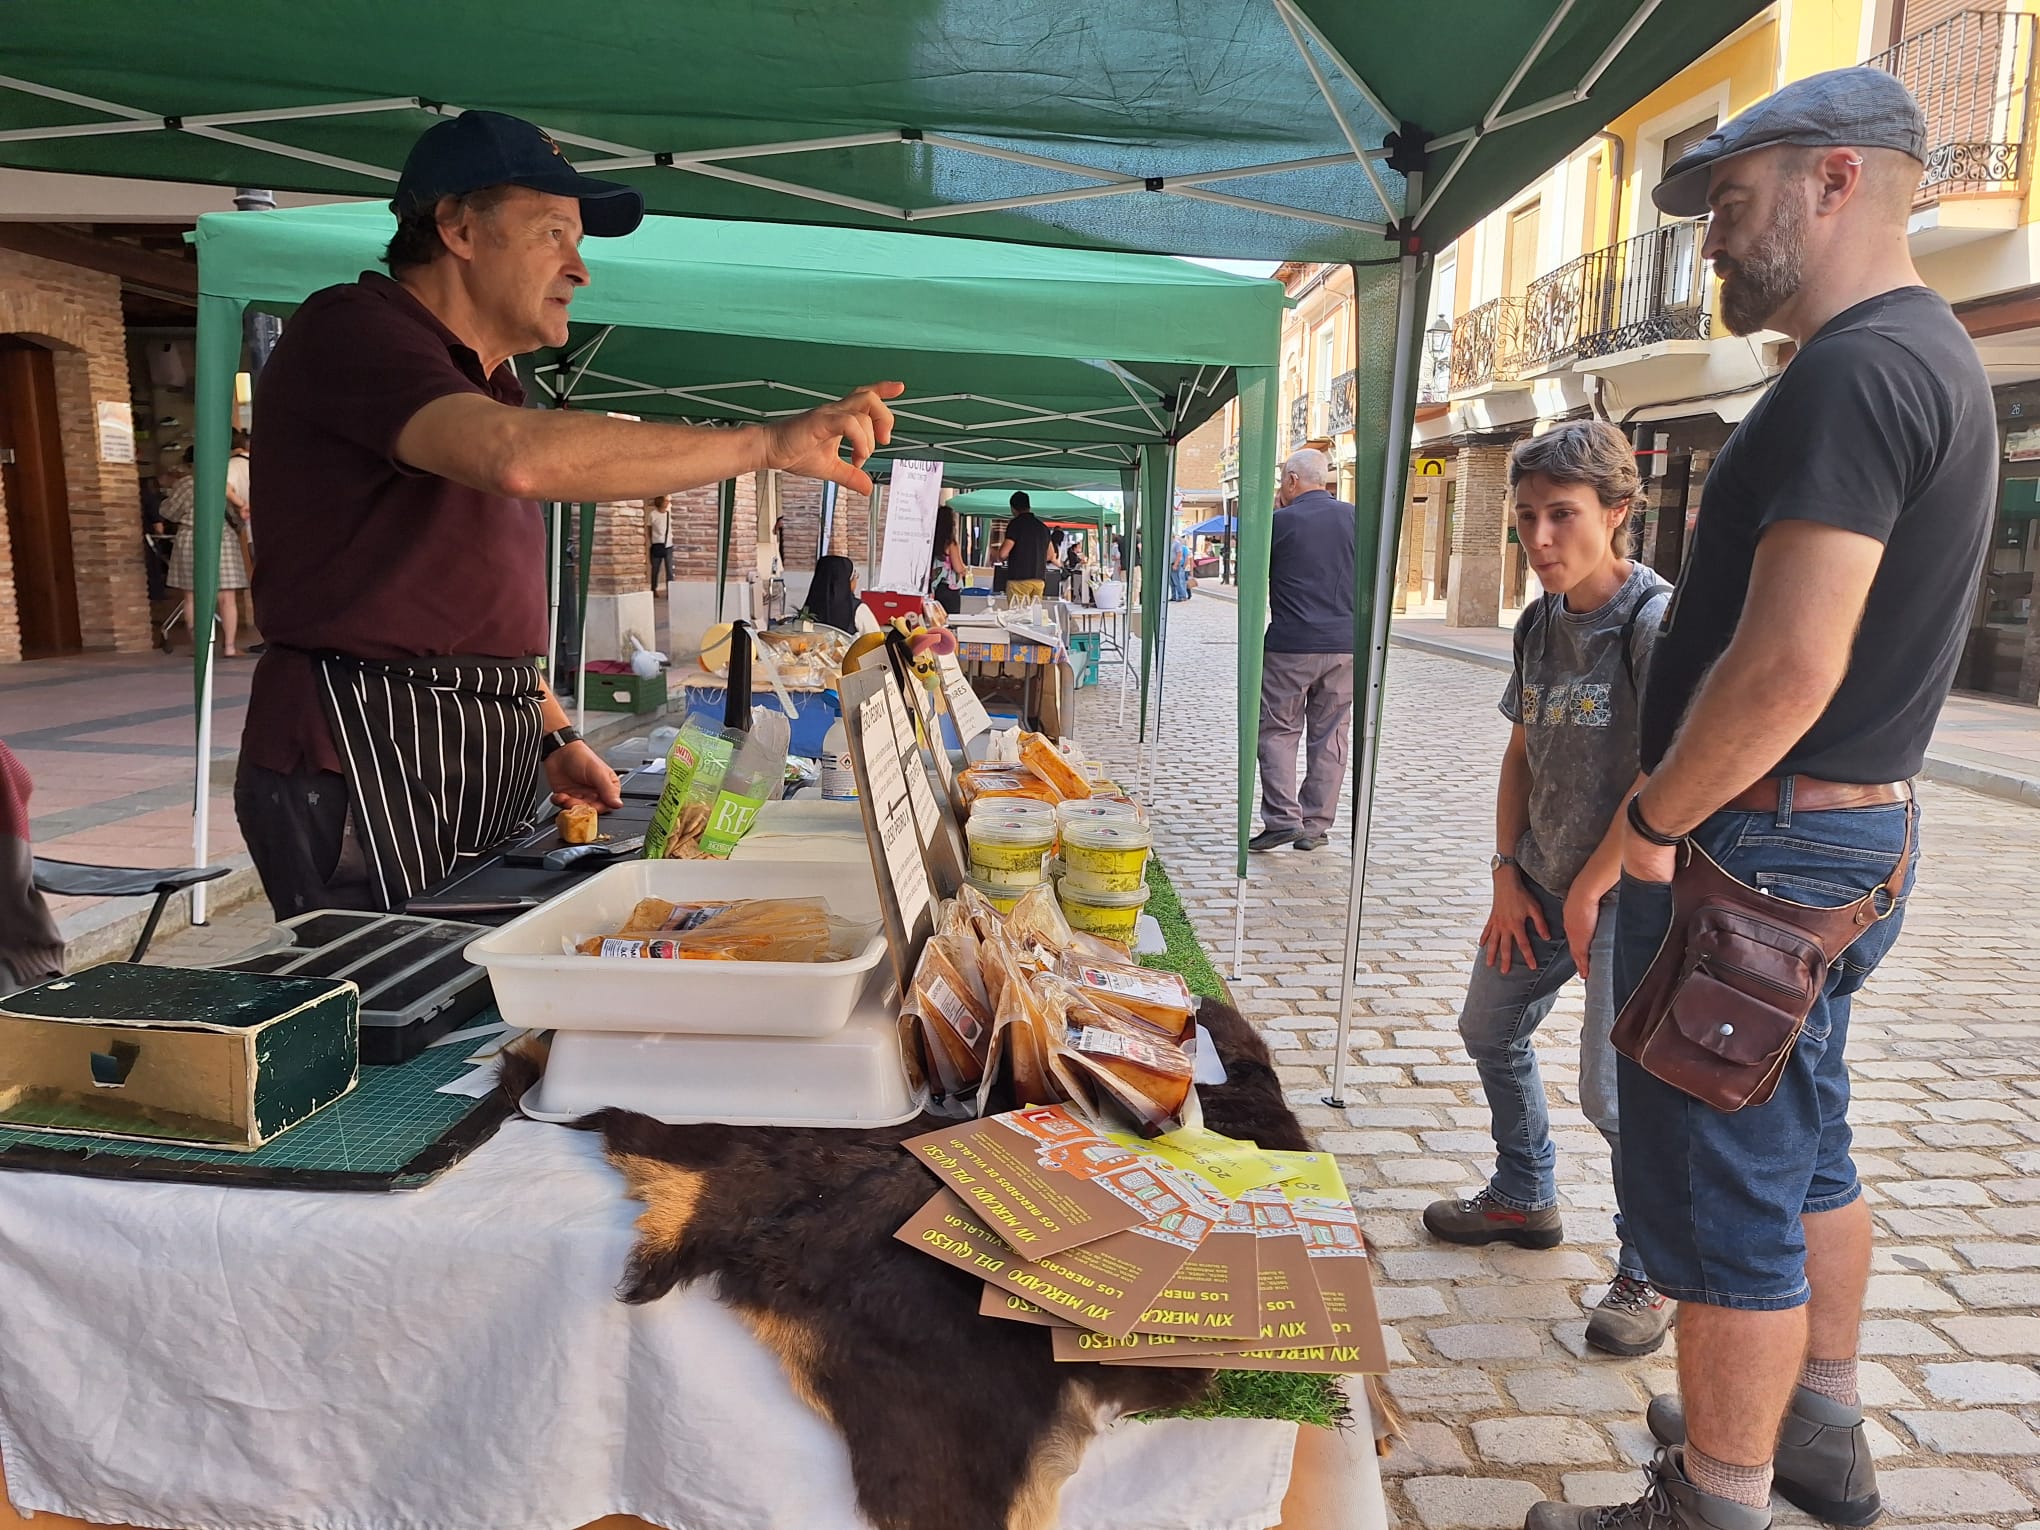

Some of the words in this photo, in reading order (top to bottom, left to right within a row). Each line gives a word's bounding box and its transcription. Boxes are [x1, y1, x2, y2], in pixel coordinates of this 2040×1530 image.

[922, 1144, 958, 1169] QUESO
[951, 1139, 988, 1169] VILLALÓN
[951, 1167, 977, 1184] DEL
[984, 1167, 1000, 1178] DE
[995, 1177, 1042, 1216] MERCADOS
[970, 1186, 1021, 1227] MERCADO
[940, 1212, 1005, 1248] VILLALÓN
[1012, 1223, 1040, 1243] XIV
[1038, 1216, 1061, 1233] LOS
[922, 1229, 973, 1258] QUESO
[974, 1253, 1005, 1272] DEL
[1008, 1269, 1084, 1310] MERCADO
[1095, 1283, 1124, 1299] LOS
[1200, 1291, 1229, 1301] LOS
[1081, 1304, 1113, 1320] XIV
[1265, 1300, 1295, 1311] LOS
[1202, 1313, 1233, 1328] XIV
[1279, 1321, 1307, 1338] XIV
[1330, 1345, 1360, 1361] XIV
